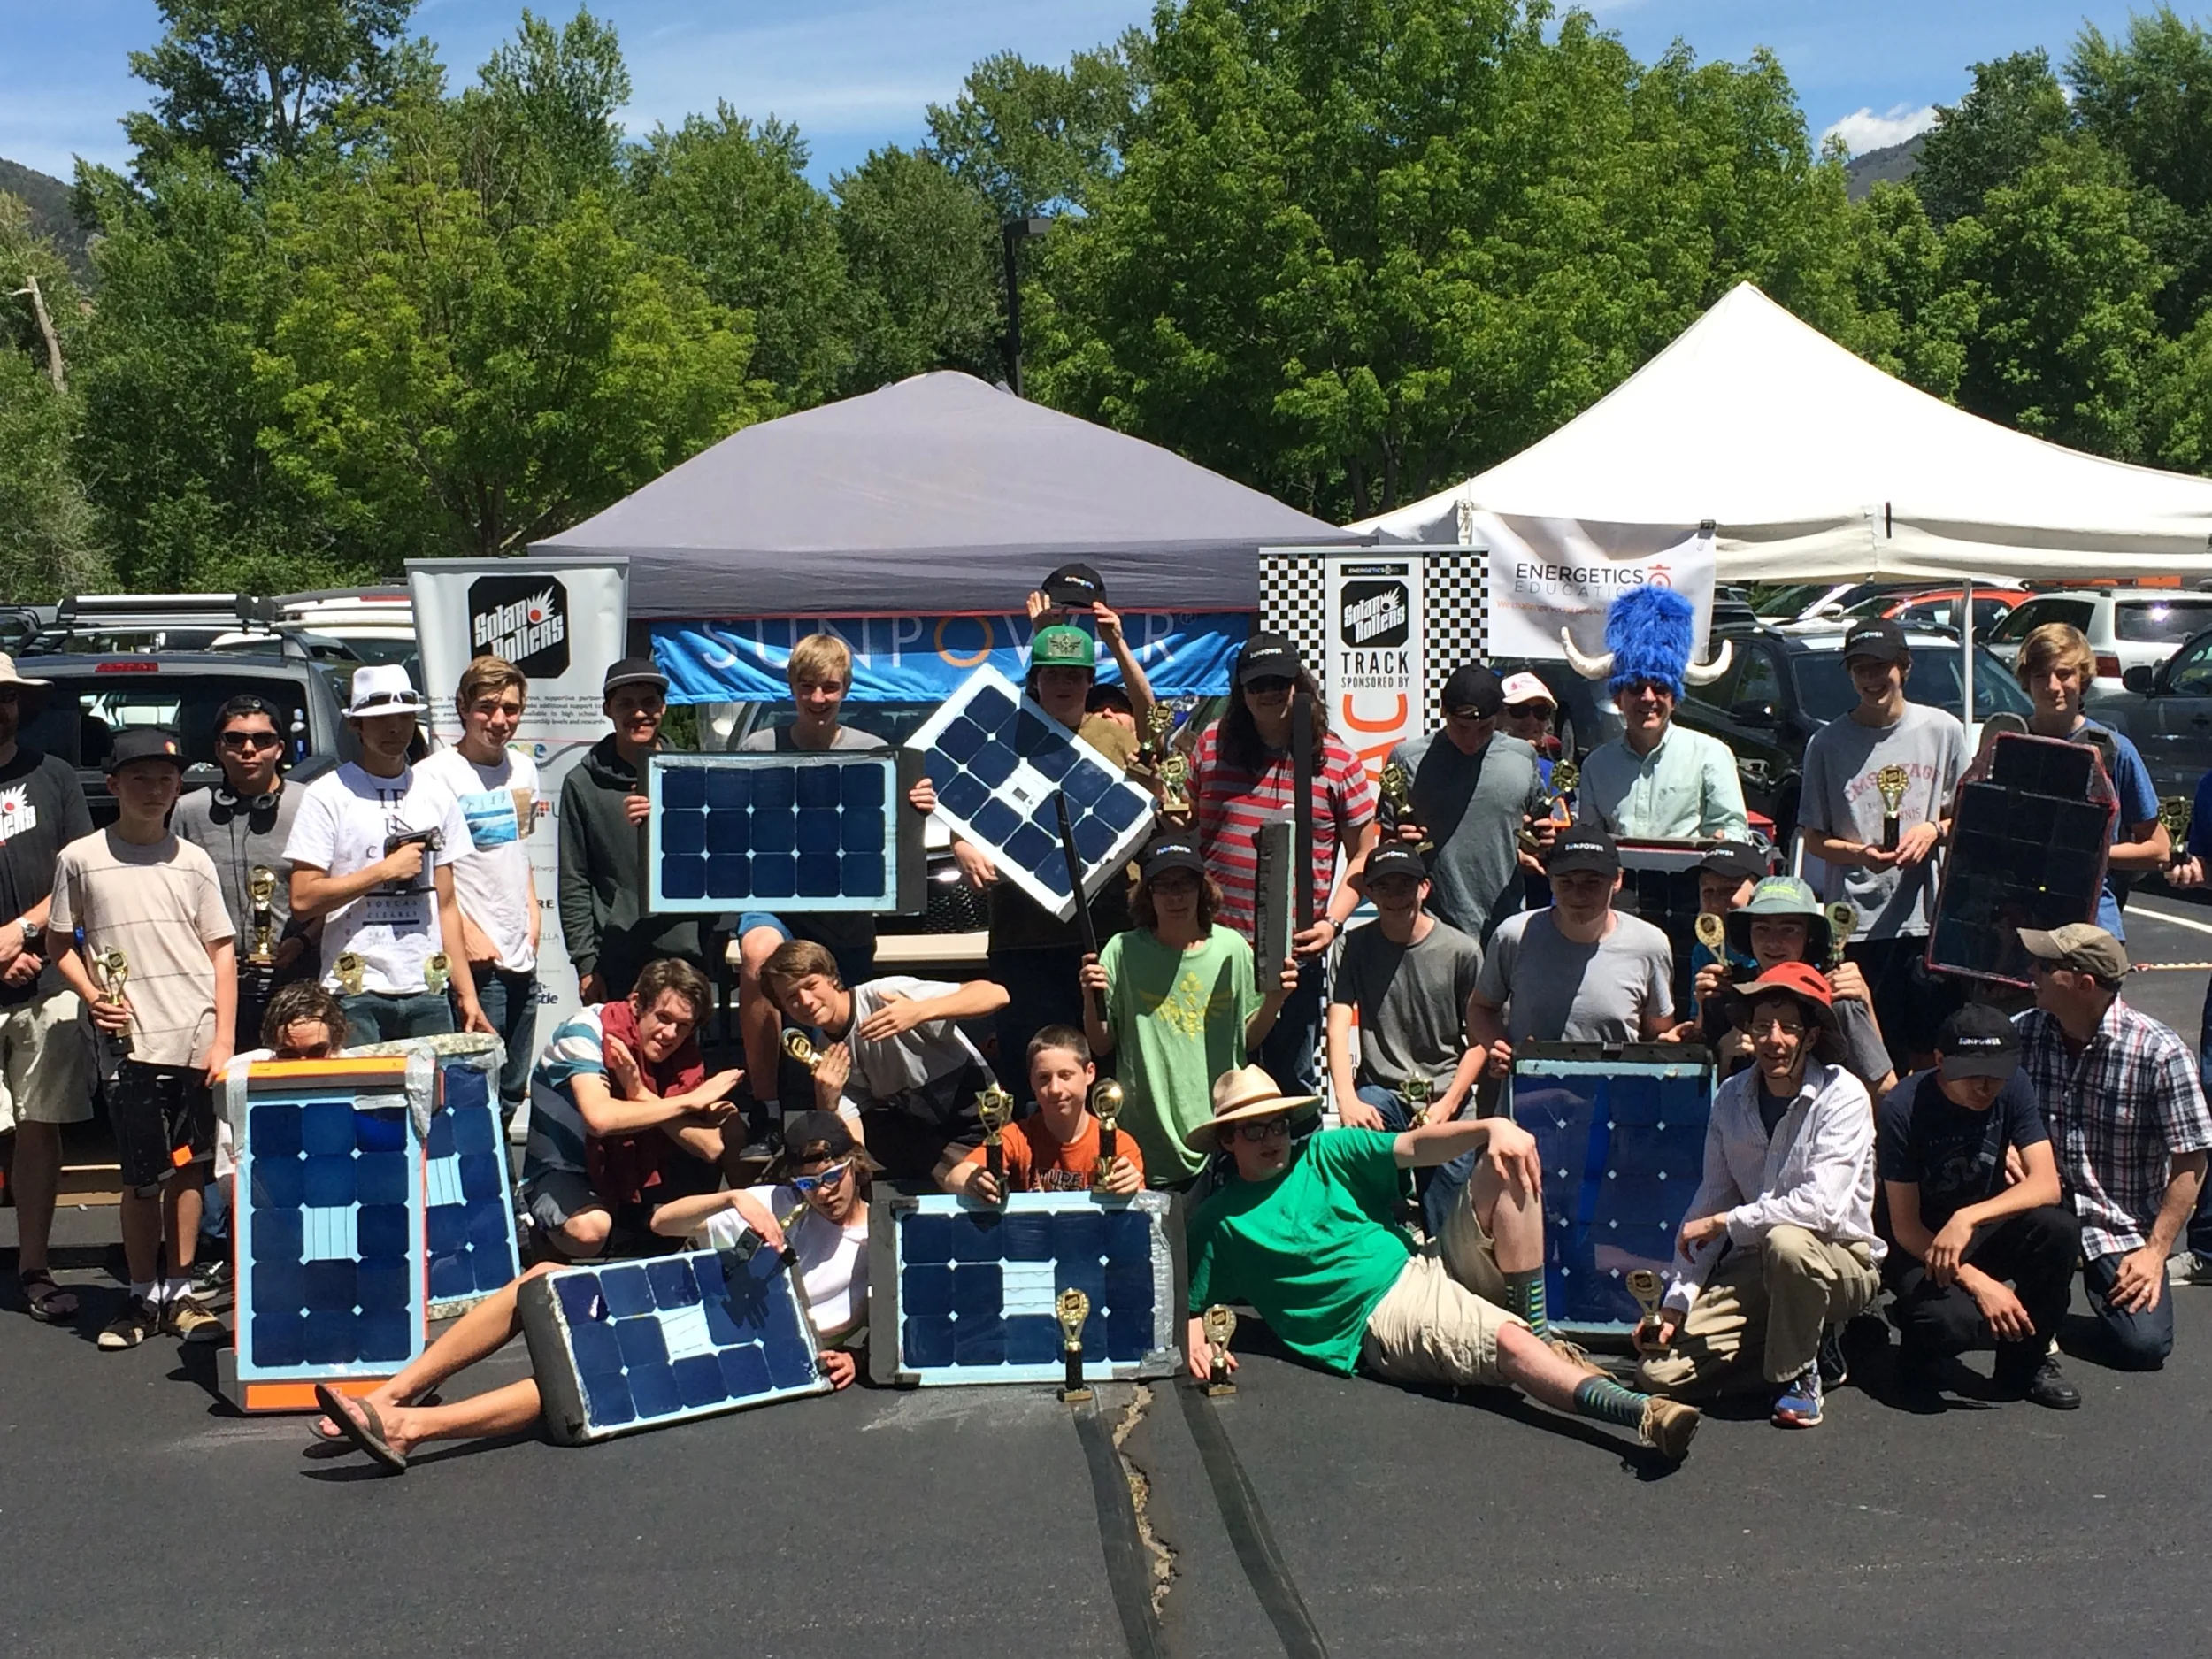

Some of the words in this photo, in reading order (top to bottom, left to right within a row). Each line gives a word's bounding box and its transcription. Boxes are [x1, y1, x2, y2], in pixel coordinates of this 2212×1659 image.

[1517, 563, 1644, 584] ENERGETICS
[1514, 580, 1627, 598] EDUCATIO
[1340, 650, 1409, 675] TRACK
[1340, 675, 1394, 688] SPONSORED
[1398, 675, 1409, 687] BY
[1564, 842, 1604, 851] SUNPOWER
